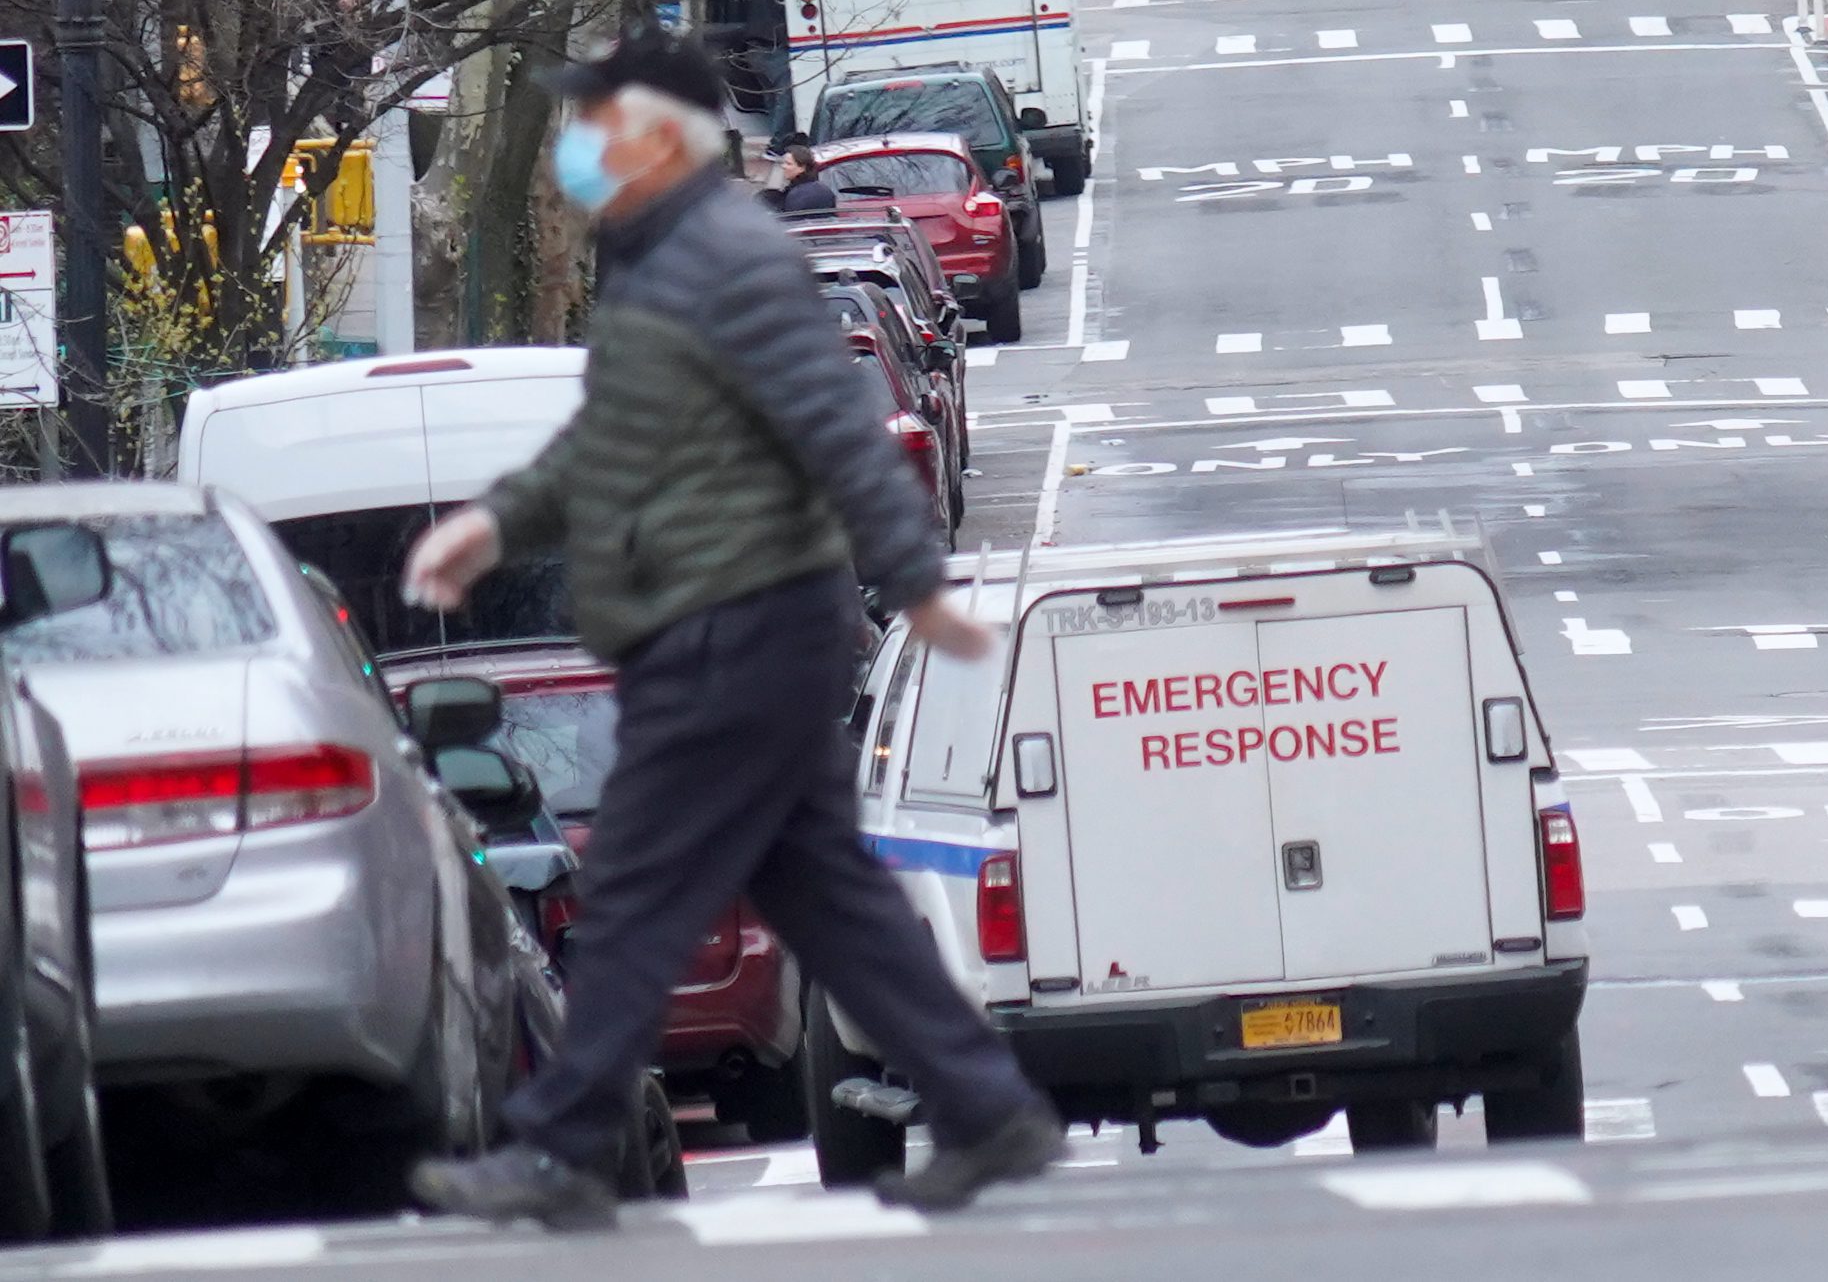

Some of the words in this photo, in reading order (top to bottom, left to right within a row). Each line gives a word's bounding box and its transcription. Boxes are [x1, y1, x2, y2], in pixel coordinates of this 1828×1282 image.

[1137, 153, 1412, 181] MPH
[1525, 144, 1790, 163] MPH
[1173, 176, 1374, 203] 20
[1552, 167, 1759, 185] 20
[1090, 446, 1470, 477] ONLY
[1040, 596, 1216, 633] TRK-S-193-13
[1091, 660, 1388, 719] EMERGENCY
[1141, 717, 1401, 772] RESPONSE
